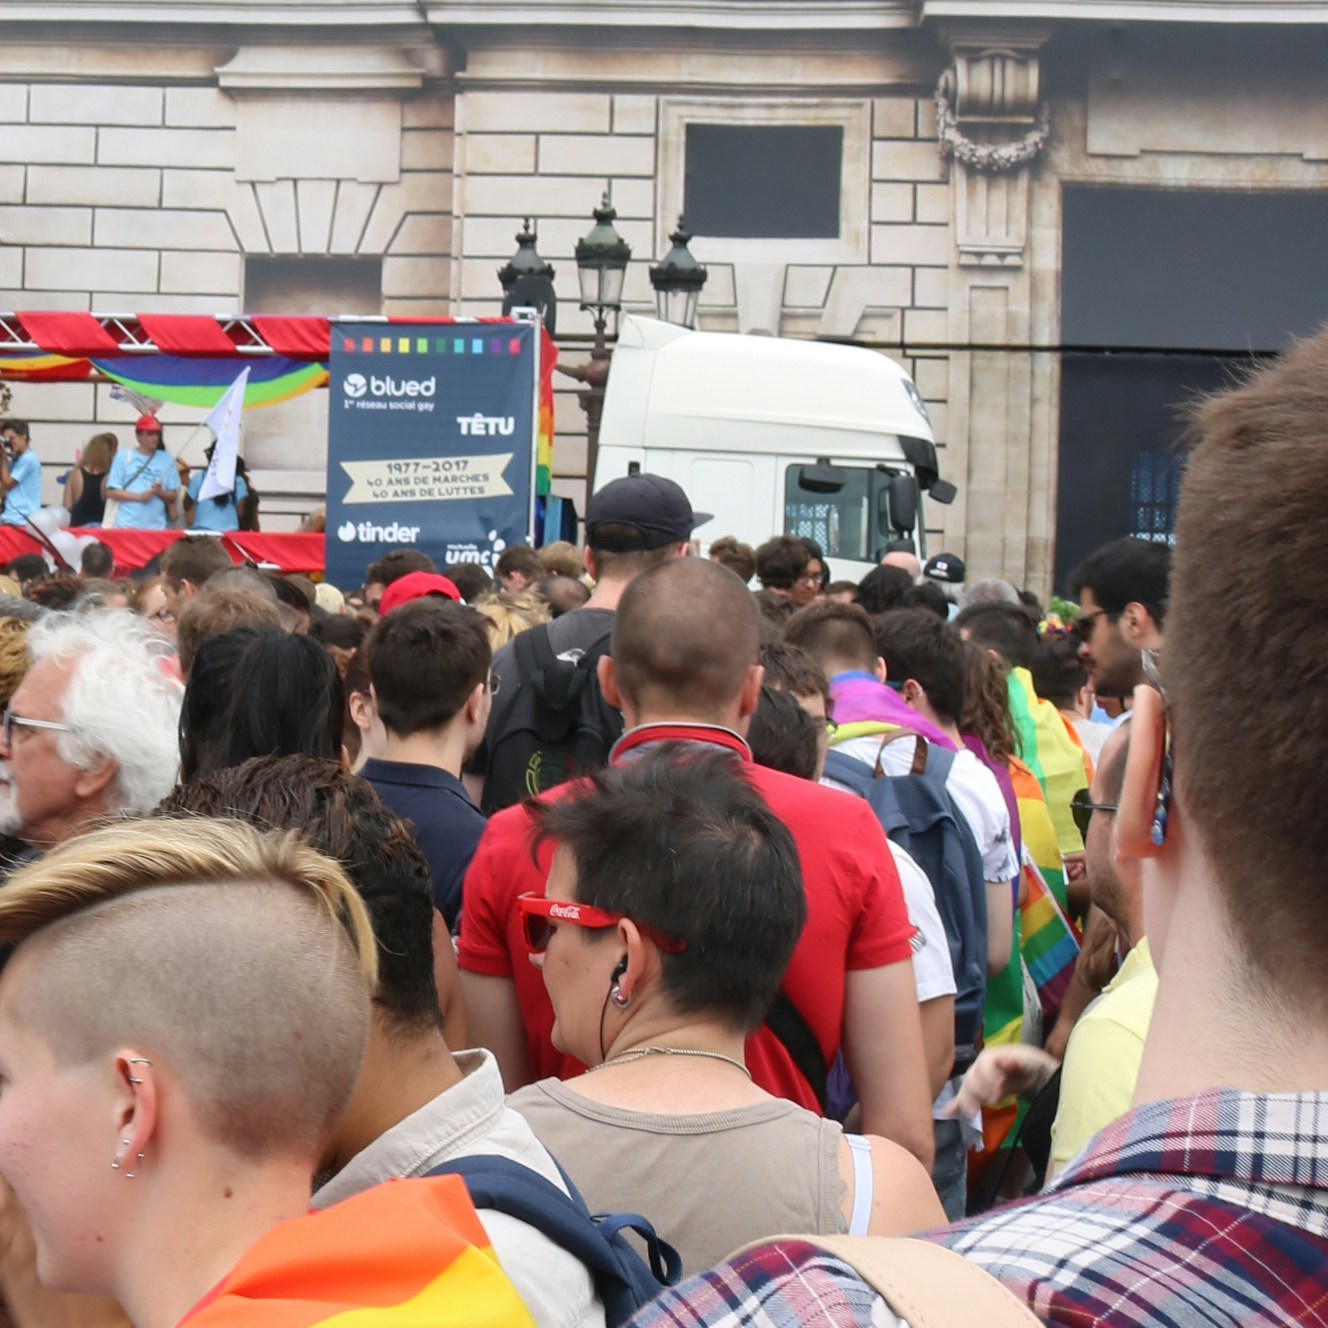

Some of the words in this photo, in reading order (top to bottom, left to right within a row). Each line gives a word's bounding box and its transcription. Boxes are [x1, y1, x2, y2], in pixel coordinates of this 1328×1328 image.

[370, 375, 436, 396] blued
[356, 400, 387, 409] réseau
[389, 400, 416, 410] social
[417, 402, 435, 412] gay
[456, 413, 515, 436] TÊTU
[366, 477, 383, 487] 40
[386, 475, 411, 486] ANS
[414, 474, 429, 485] DE
[432, 473, 490, 484] MARCHES
[372, 489, 389, 499] 40
[392, 488, 416, 498] ANS
[419, 487, 435, 497] DE
[438, 485, 485, 497] LUTTES
[357, 521, 420, 543] tinder
